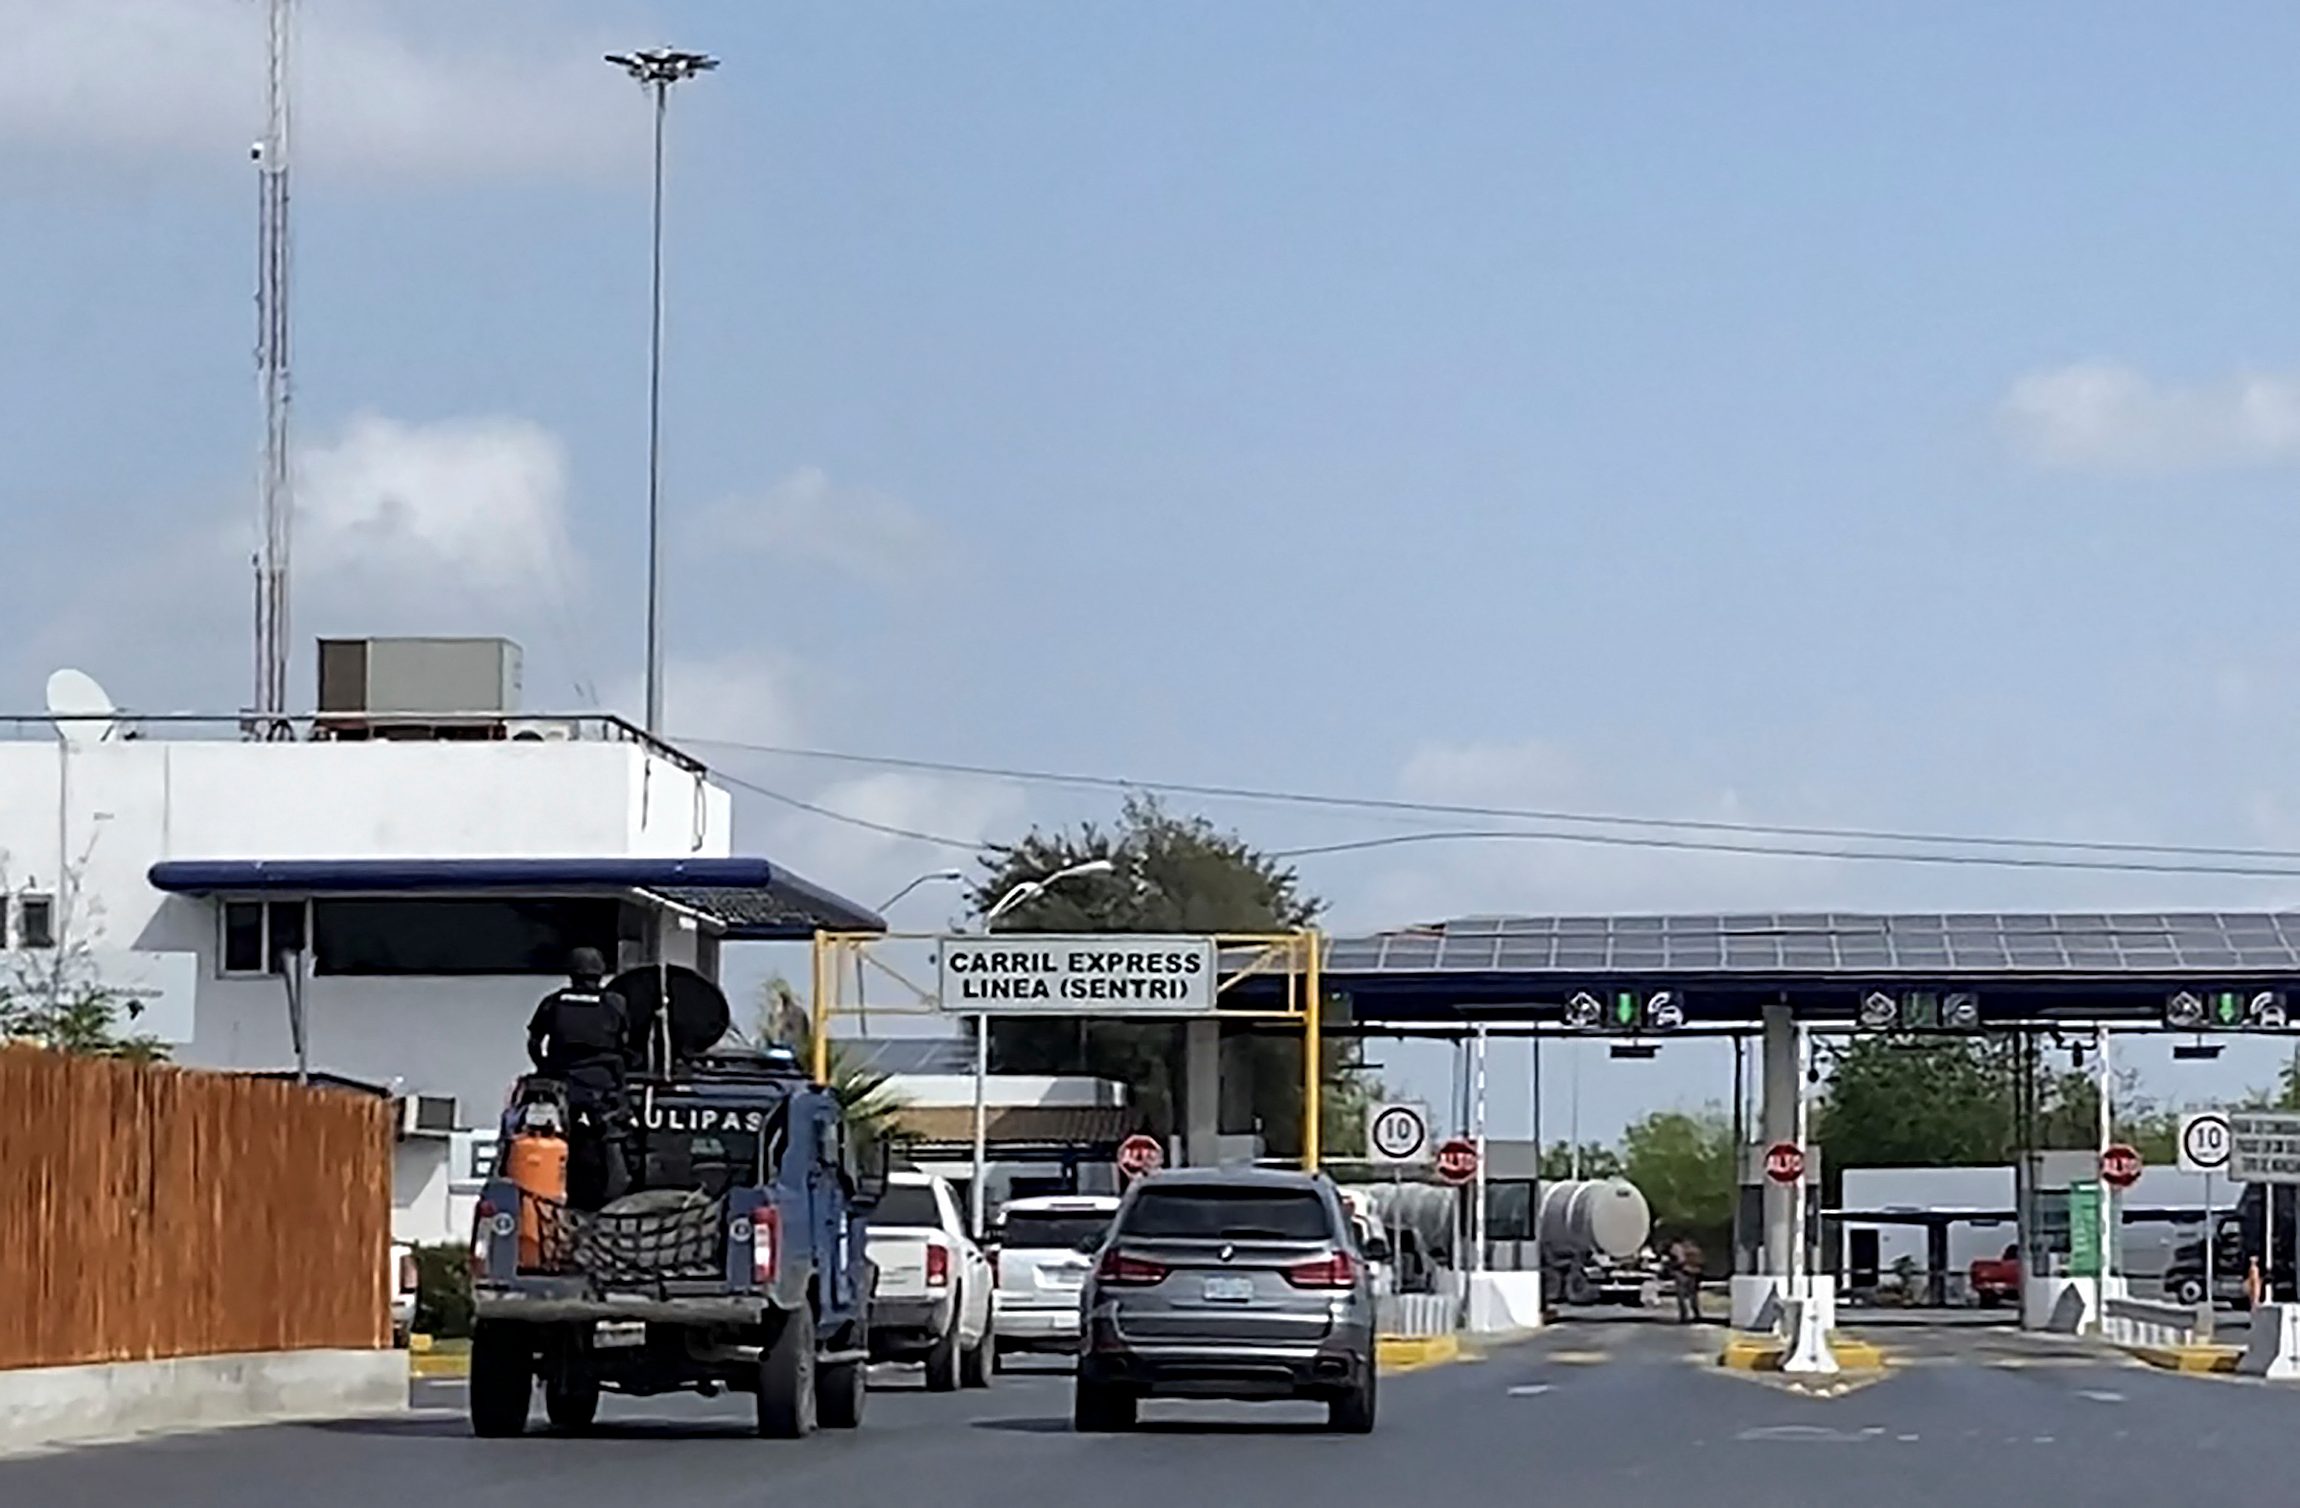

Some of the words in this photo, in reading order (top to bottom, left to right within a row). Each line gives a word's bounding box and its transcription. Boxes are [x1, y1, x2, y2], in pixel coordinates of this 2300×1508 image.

[949, 952, 1058, 973] CARRIL
[1067, 952, 1201, 973] EXPRESS
[962, 978, 1050, 999] LINEA
[1060, 978, 1188, 999] (SENTRI)
[1386, 1117, 1412, 1140] 10
[2197, 1126, 2221, 1149] 10
